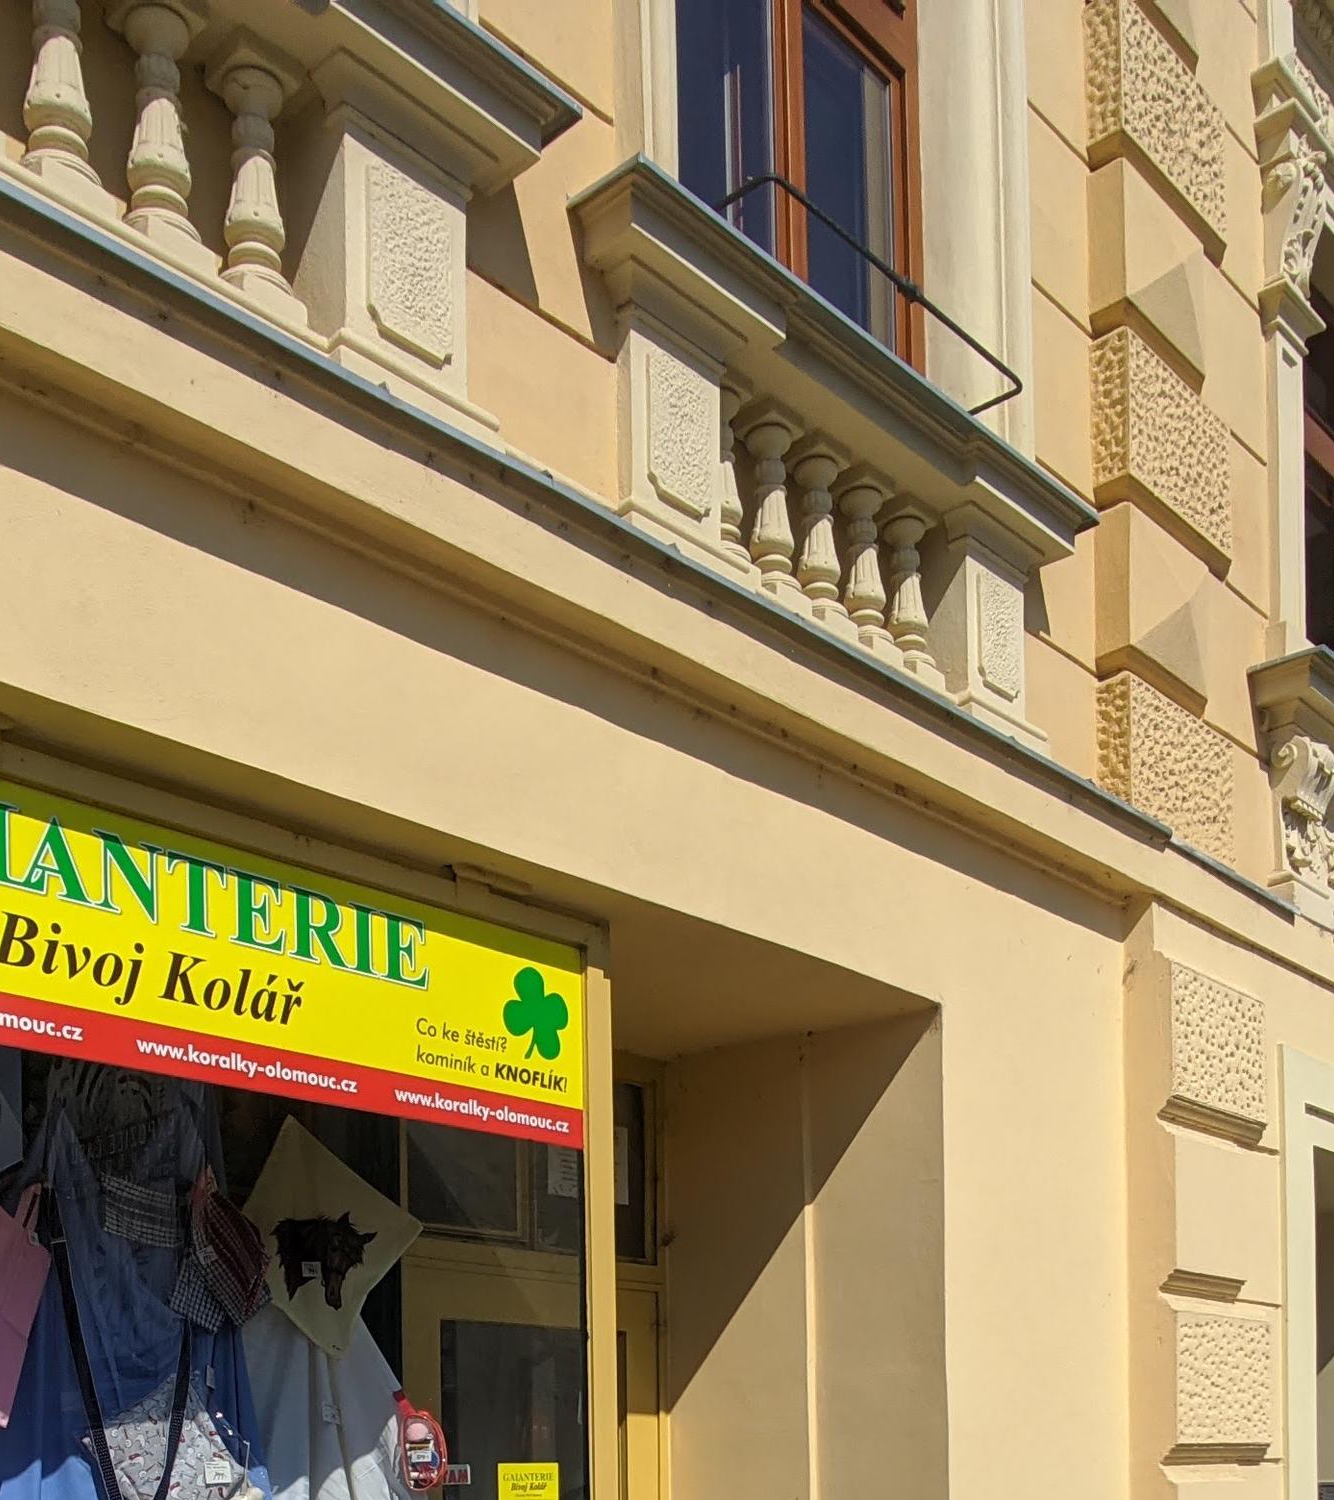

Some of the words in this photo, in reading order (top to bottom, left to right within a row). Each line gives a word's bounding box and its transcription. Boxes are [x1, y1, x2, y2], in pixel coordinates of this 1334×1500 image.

[158, 951, 306, 1026] Kolář
[416, 1017, 437, 1039] Co
[442, 1022, 460, 1042] ke
[464, 1028, 508, 1054] štěstí?
[136, 1036, 358, 1095] www.koralky-olomouc.cz
[416, 1045, 476, 1076] kominík
[480, 1063, 490, 1078] a
[494, 1062, 569, 1094] KNOFLÍK!
[394, 1087, 570, 1134] www.koralky-olomouc.cz
